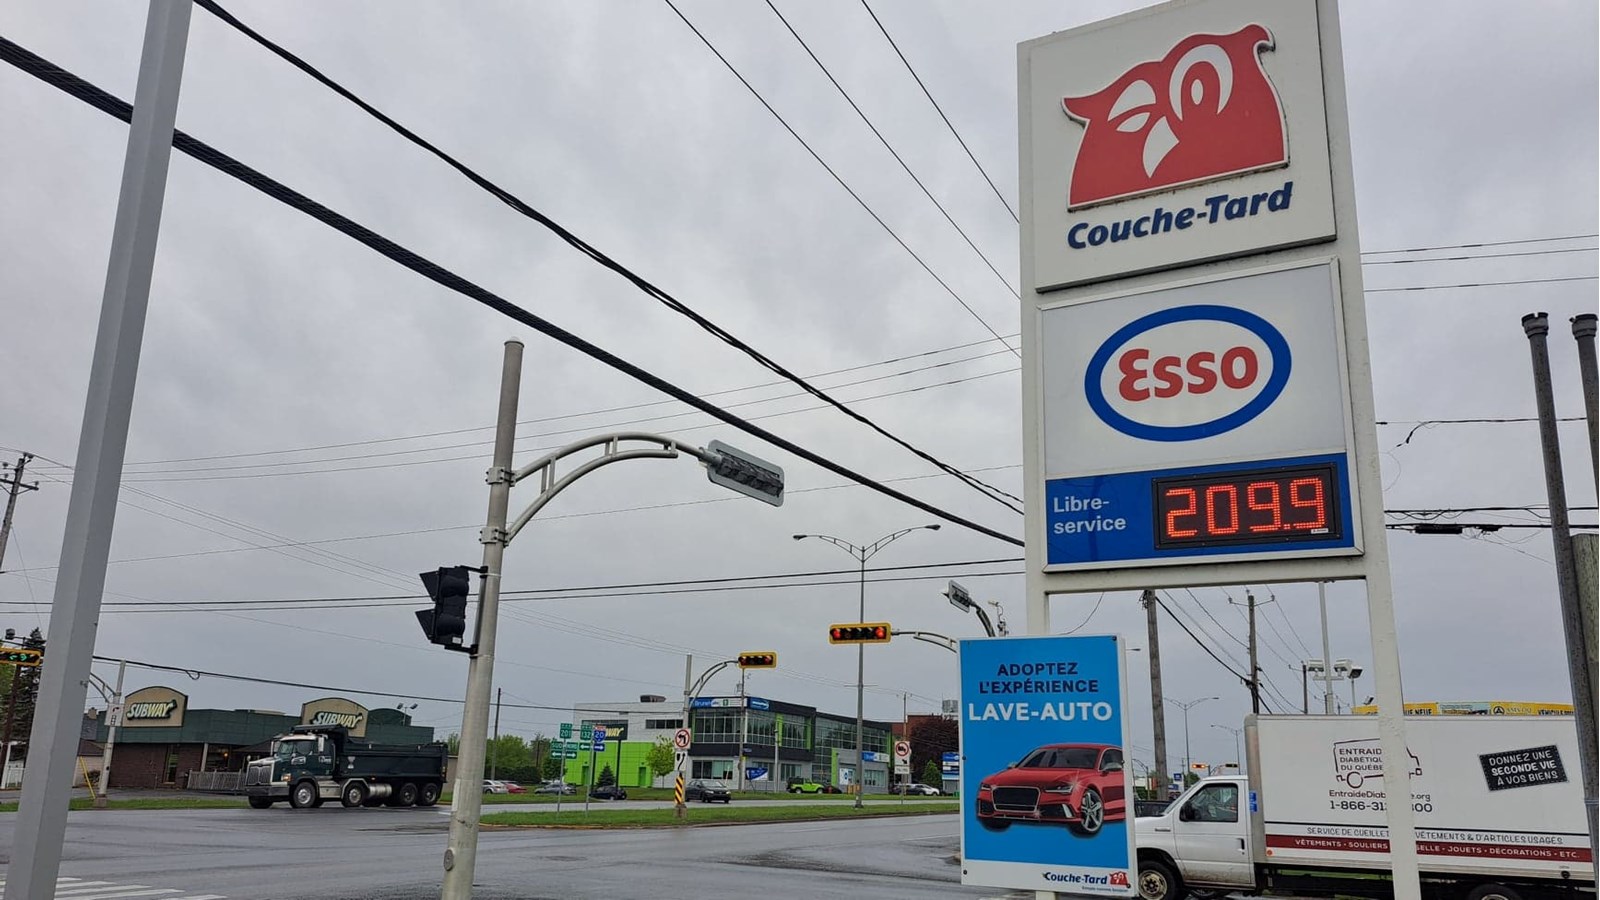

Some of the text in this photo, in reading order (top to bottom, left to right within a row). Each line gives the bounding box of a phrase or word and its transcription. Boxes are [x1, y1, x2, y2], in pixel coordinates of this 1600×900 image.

[1067, 182, 1293, 249] Couche-Tard
[1118, 346, 1258, 402] Esso
[1053, 496, 1109, 513] Libre-
[1165, 477, 1325, 538] 209.9
[1053, 516, 1126, 534] service
[997, 662, 1078, 676] ADOPTEZ
[979, 679, 1098, 694] L'EXPÉRIENCE
[127, 702, 175, 718] SUBWAY
[968, 701, 1112, 721] LAVE-AUTO
[313, 712, 363, 728] SUBWAY
[595, 731, 605, 739] 20
[1338, 748, 1382, 756] ENTRAID
[1489, 750, 1552, 766] DONNEZ UNE
[1355, 763, 1384, 771] QUÉBE
[1491, 760, 1557, 776] SECONDE VIE
[1506, 774, 1527, 784] VOS
[1528, 770, 1559, 782] BIENS
[1306, 827, 1389, 838] SERVICE DE CUEILLET
[1467, 833, 1474, 841] &
[1348, 841, 1388, 850] SOULIERS
[1447, 845, 1482, 853] JOUETS
[1044, 872, 1107, 885] Couche-Tard
